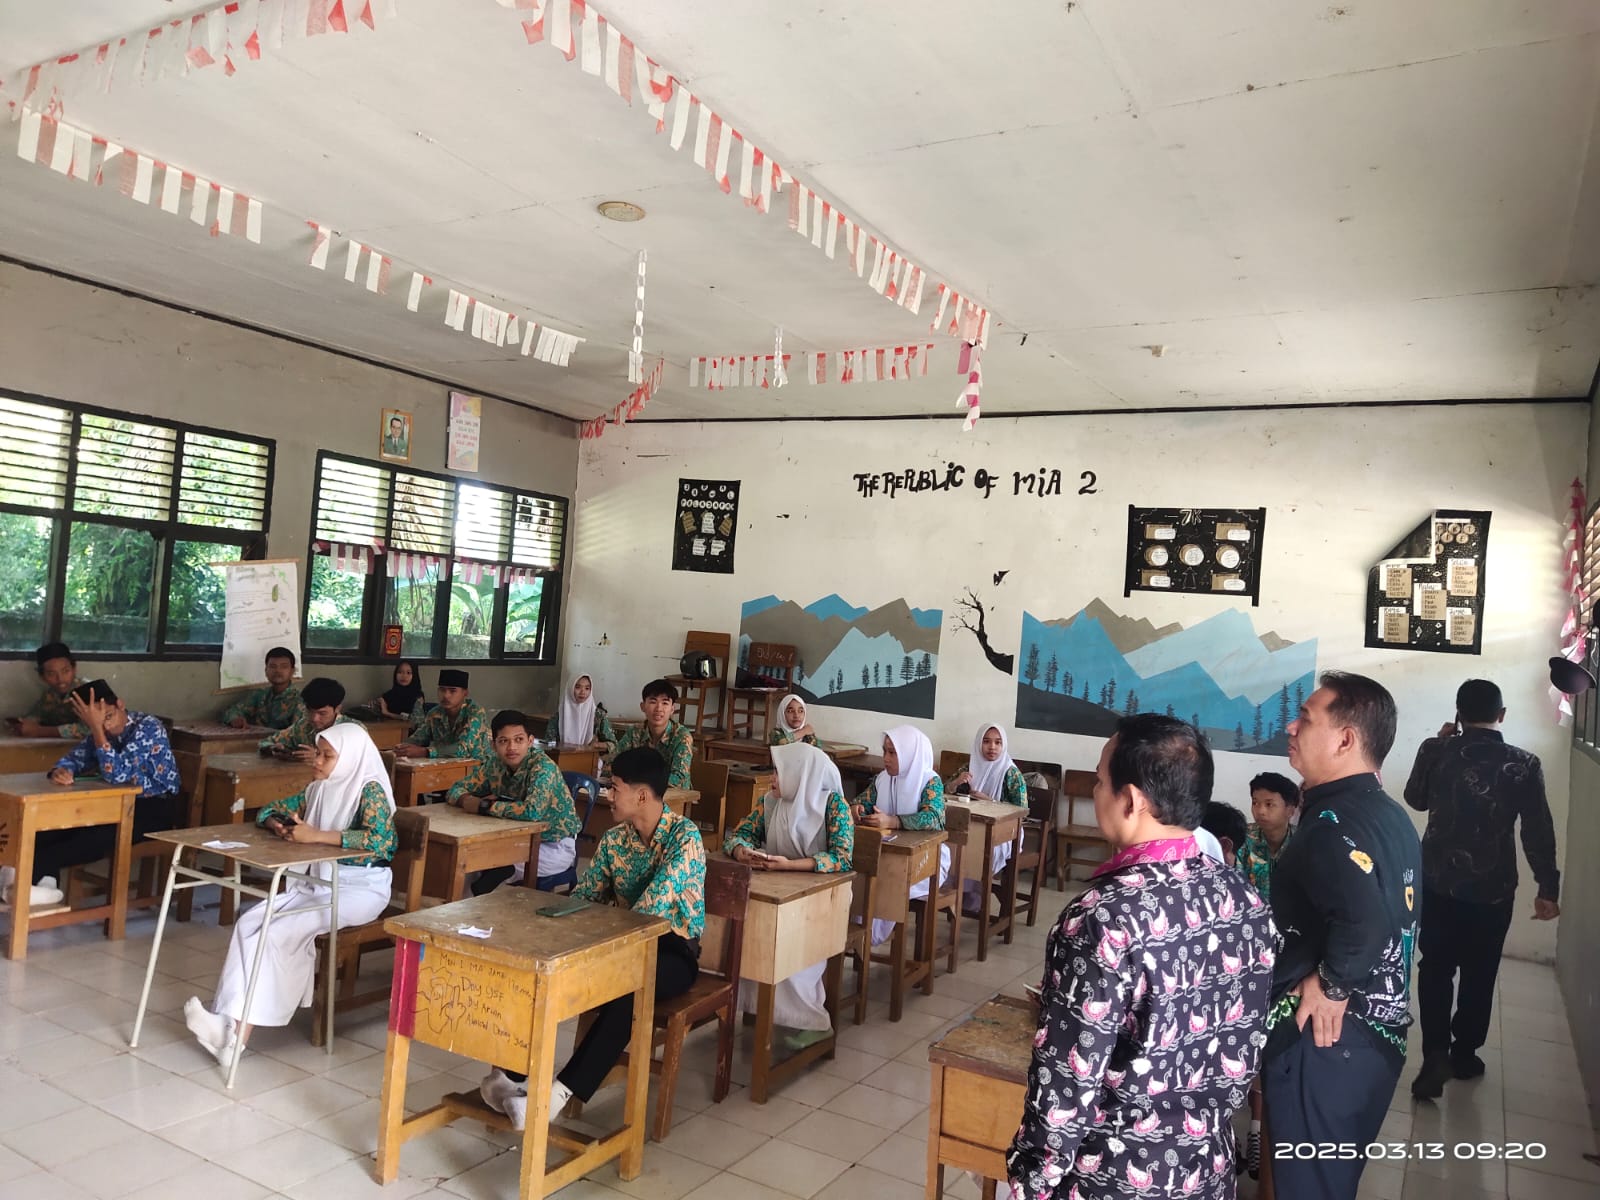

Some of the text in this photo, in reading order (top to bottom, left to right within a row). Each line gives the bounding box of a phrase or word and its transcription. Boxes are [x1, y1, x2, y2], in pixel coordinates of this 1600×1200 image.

[853, 472, 880, 498] THE
[974, 468, 1000, 499] OF
[1078, 470, 1097, 495] 2
